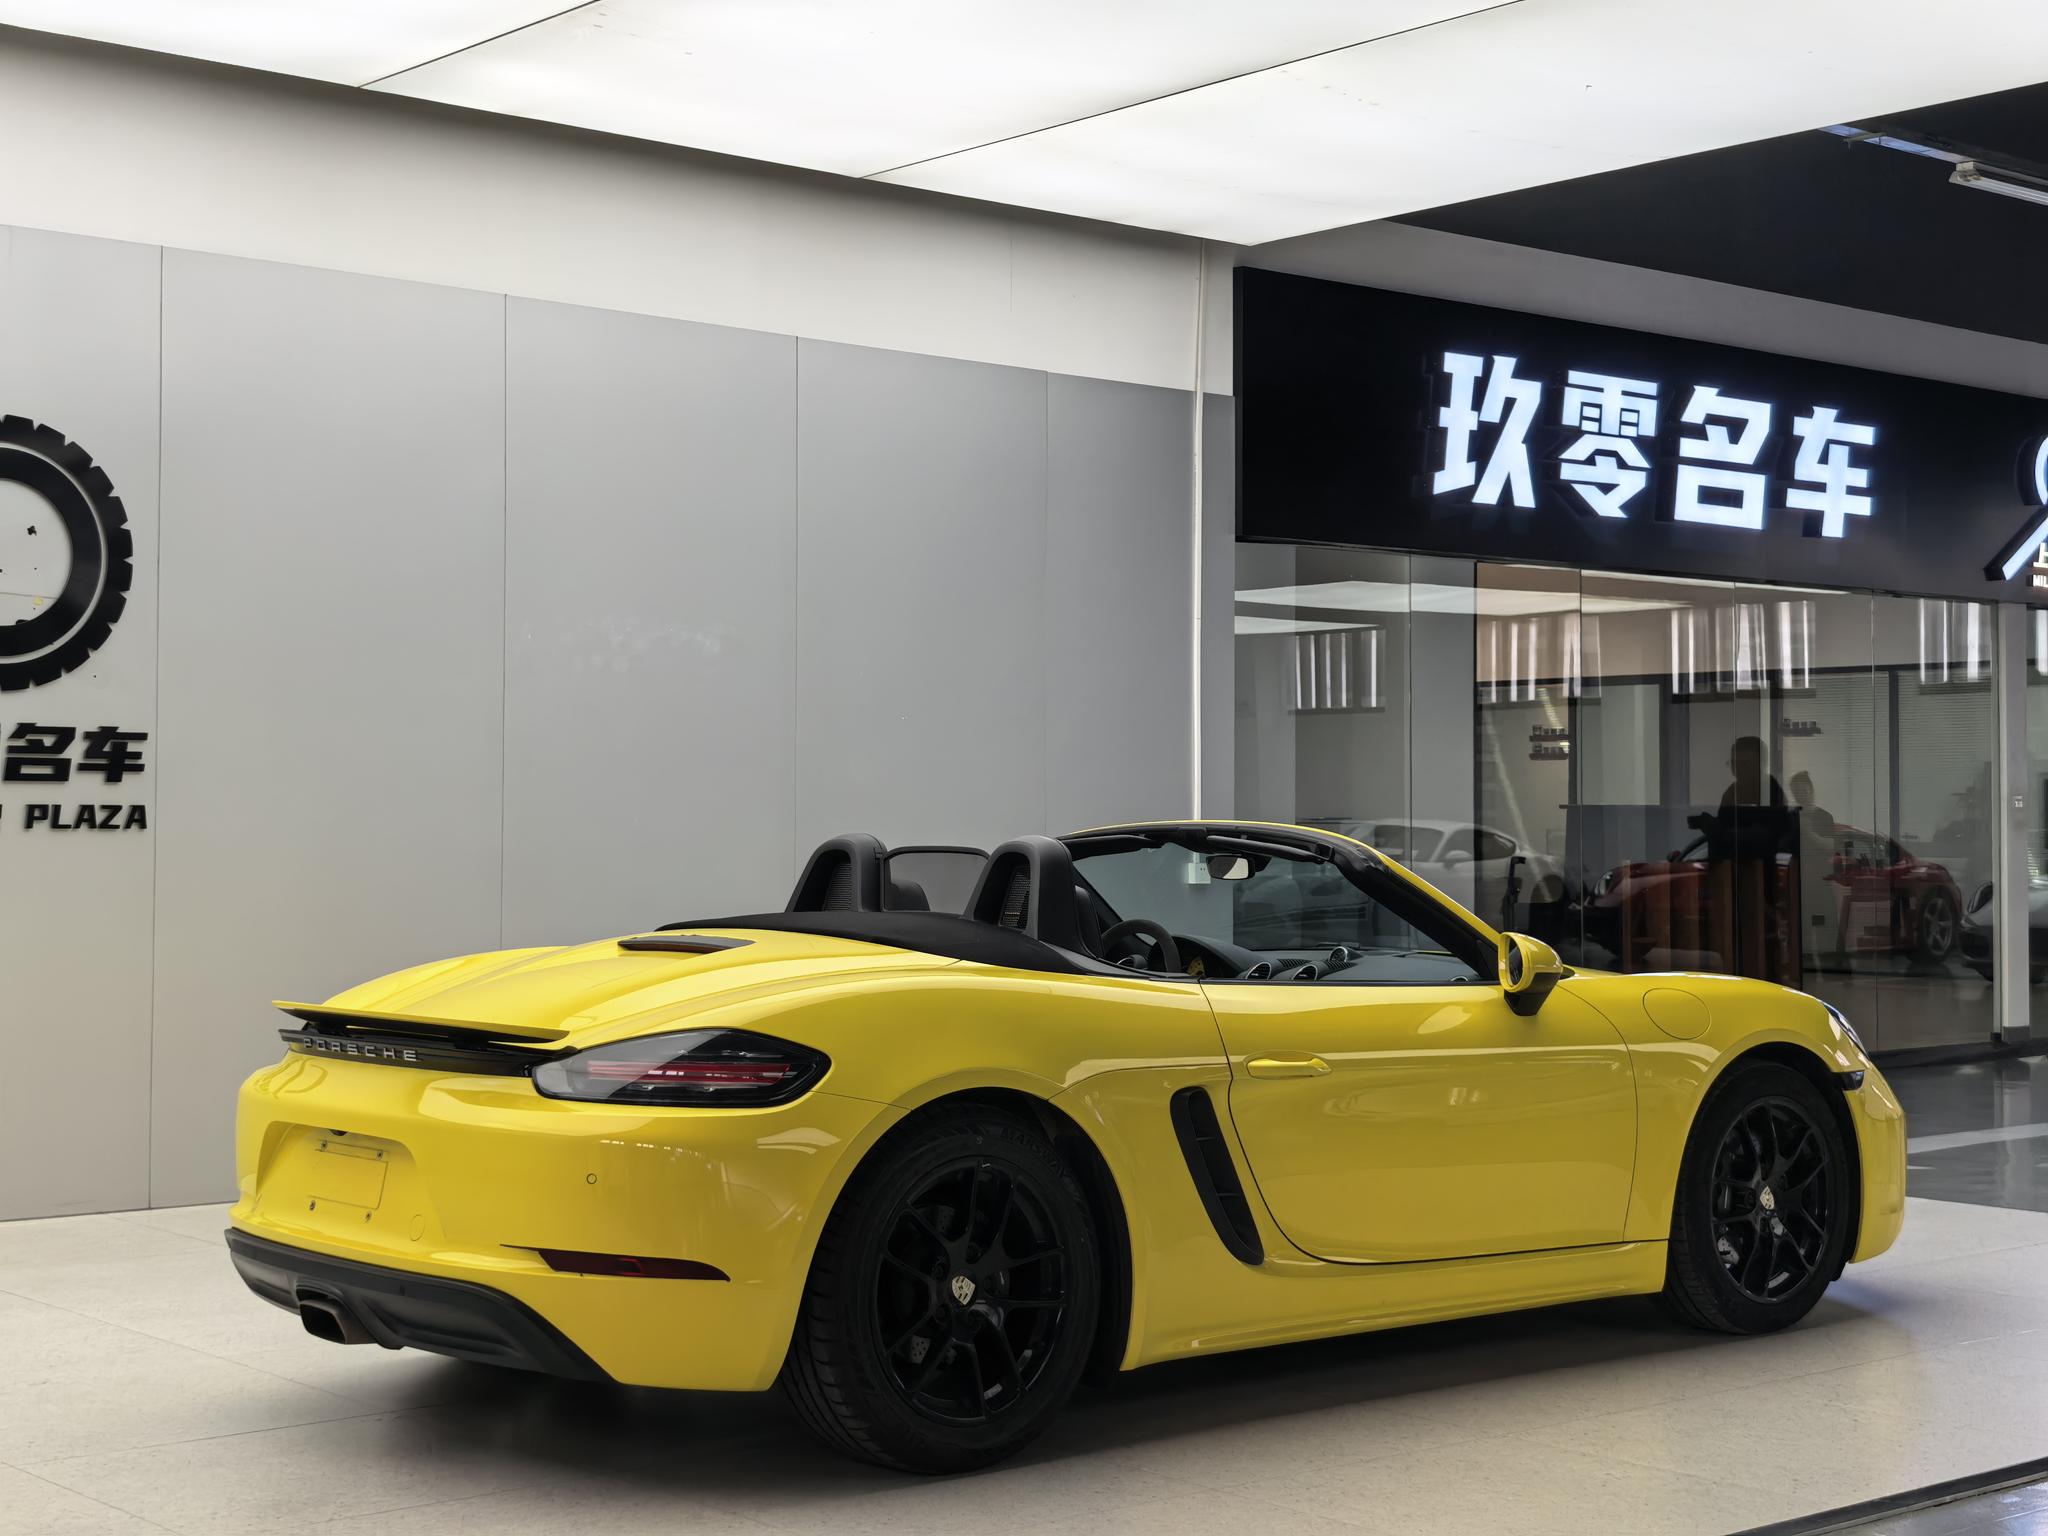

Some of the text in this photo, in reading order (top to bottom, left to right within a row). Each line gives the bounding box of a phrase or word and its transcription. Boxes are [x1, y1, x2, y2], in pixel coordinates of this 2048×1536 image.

[1433, 351, 1876, 538] 玖零名车
[3, 722, 149, 783] 名车
[24, 803, 148, 830] PLAZA
[303, 1038, 417, 1062] PORSCHE
